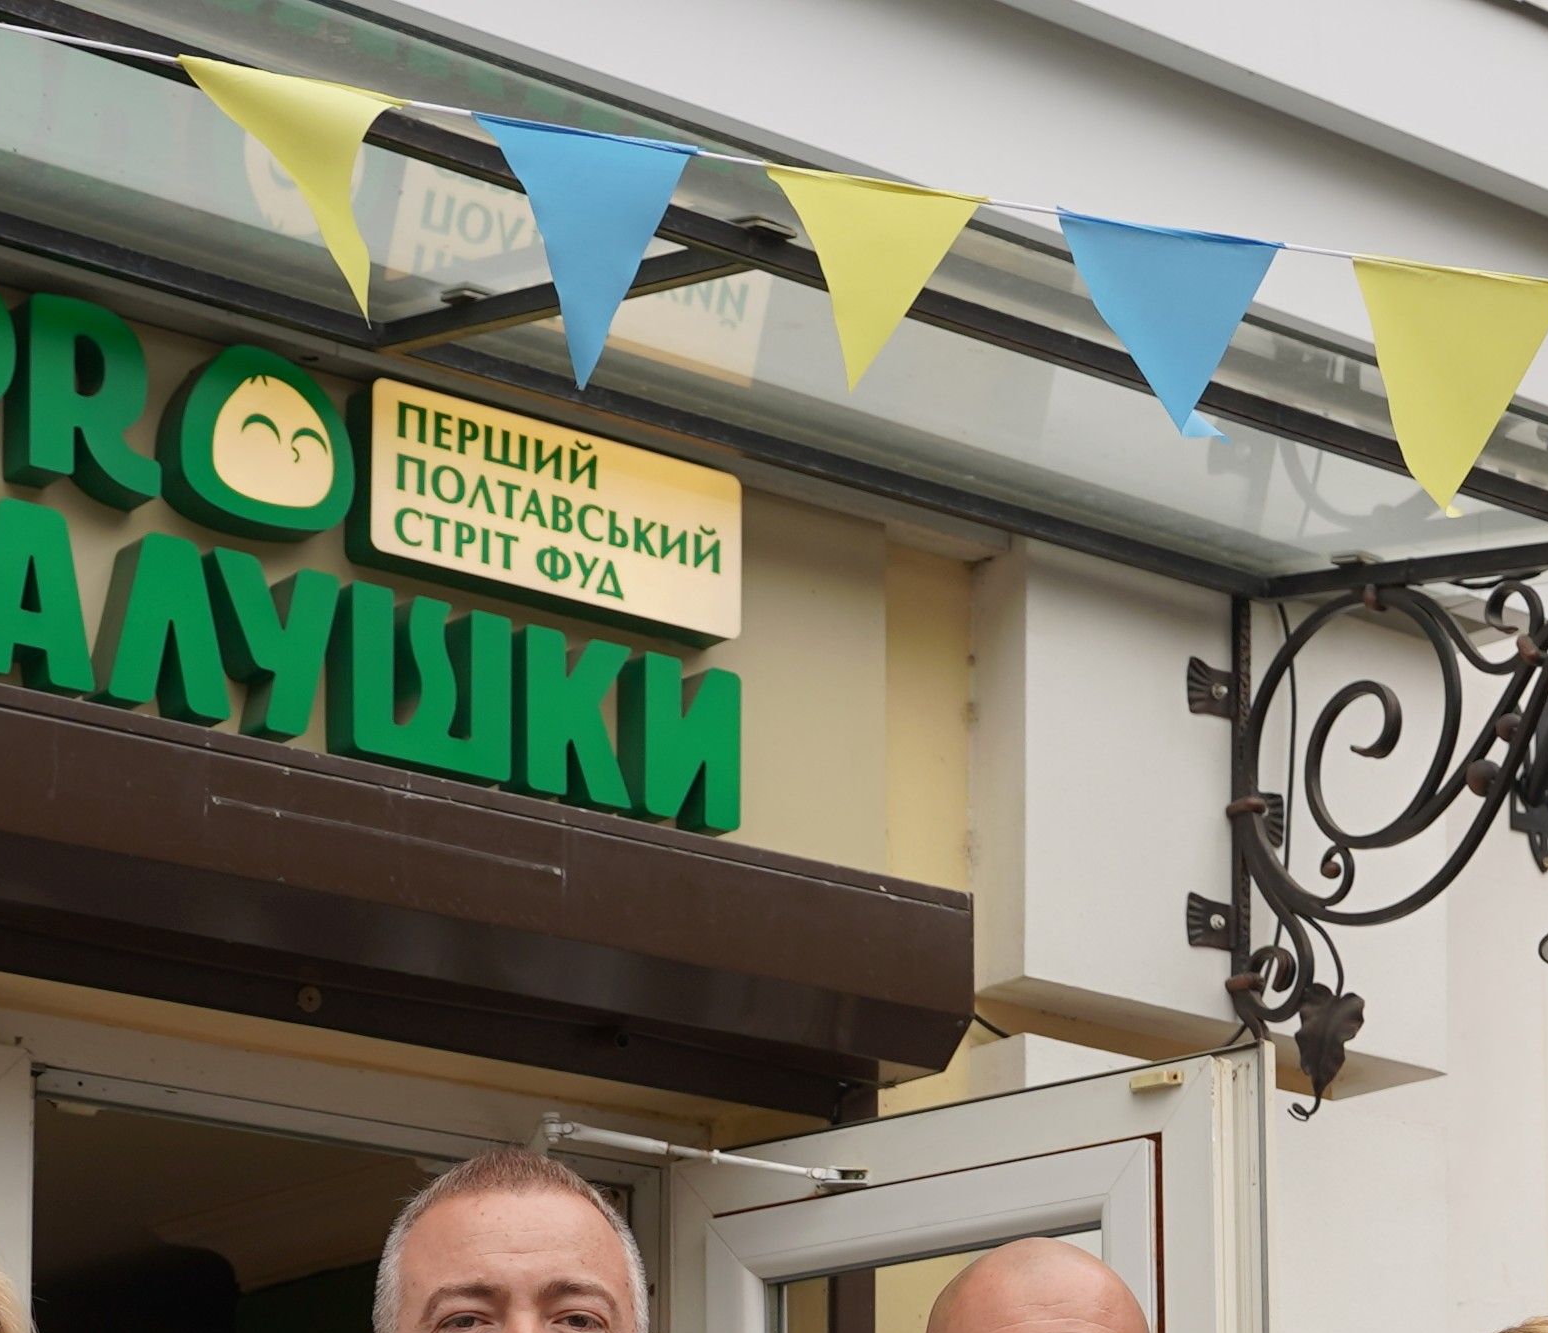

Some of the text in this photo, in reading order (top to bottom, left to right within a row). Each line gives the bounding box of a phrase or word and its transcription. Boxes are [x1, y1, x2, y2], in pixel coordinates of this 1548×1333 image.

[397, 400, 598, 490] ПЕРШИЙ
[394, 507, 625, 601] СТРІТ ФУД
[396, 453, 721, 575] ПОЛТАВСЬКИЙ
